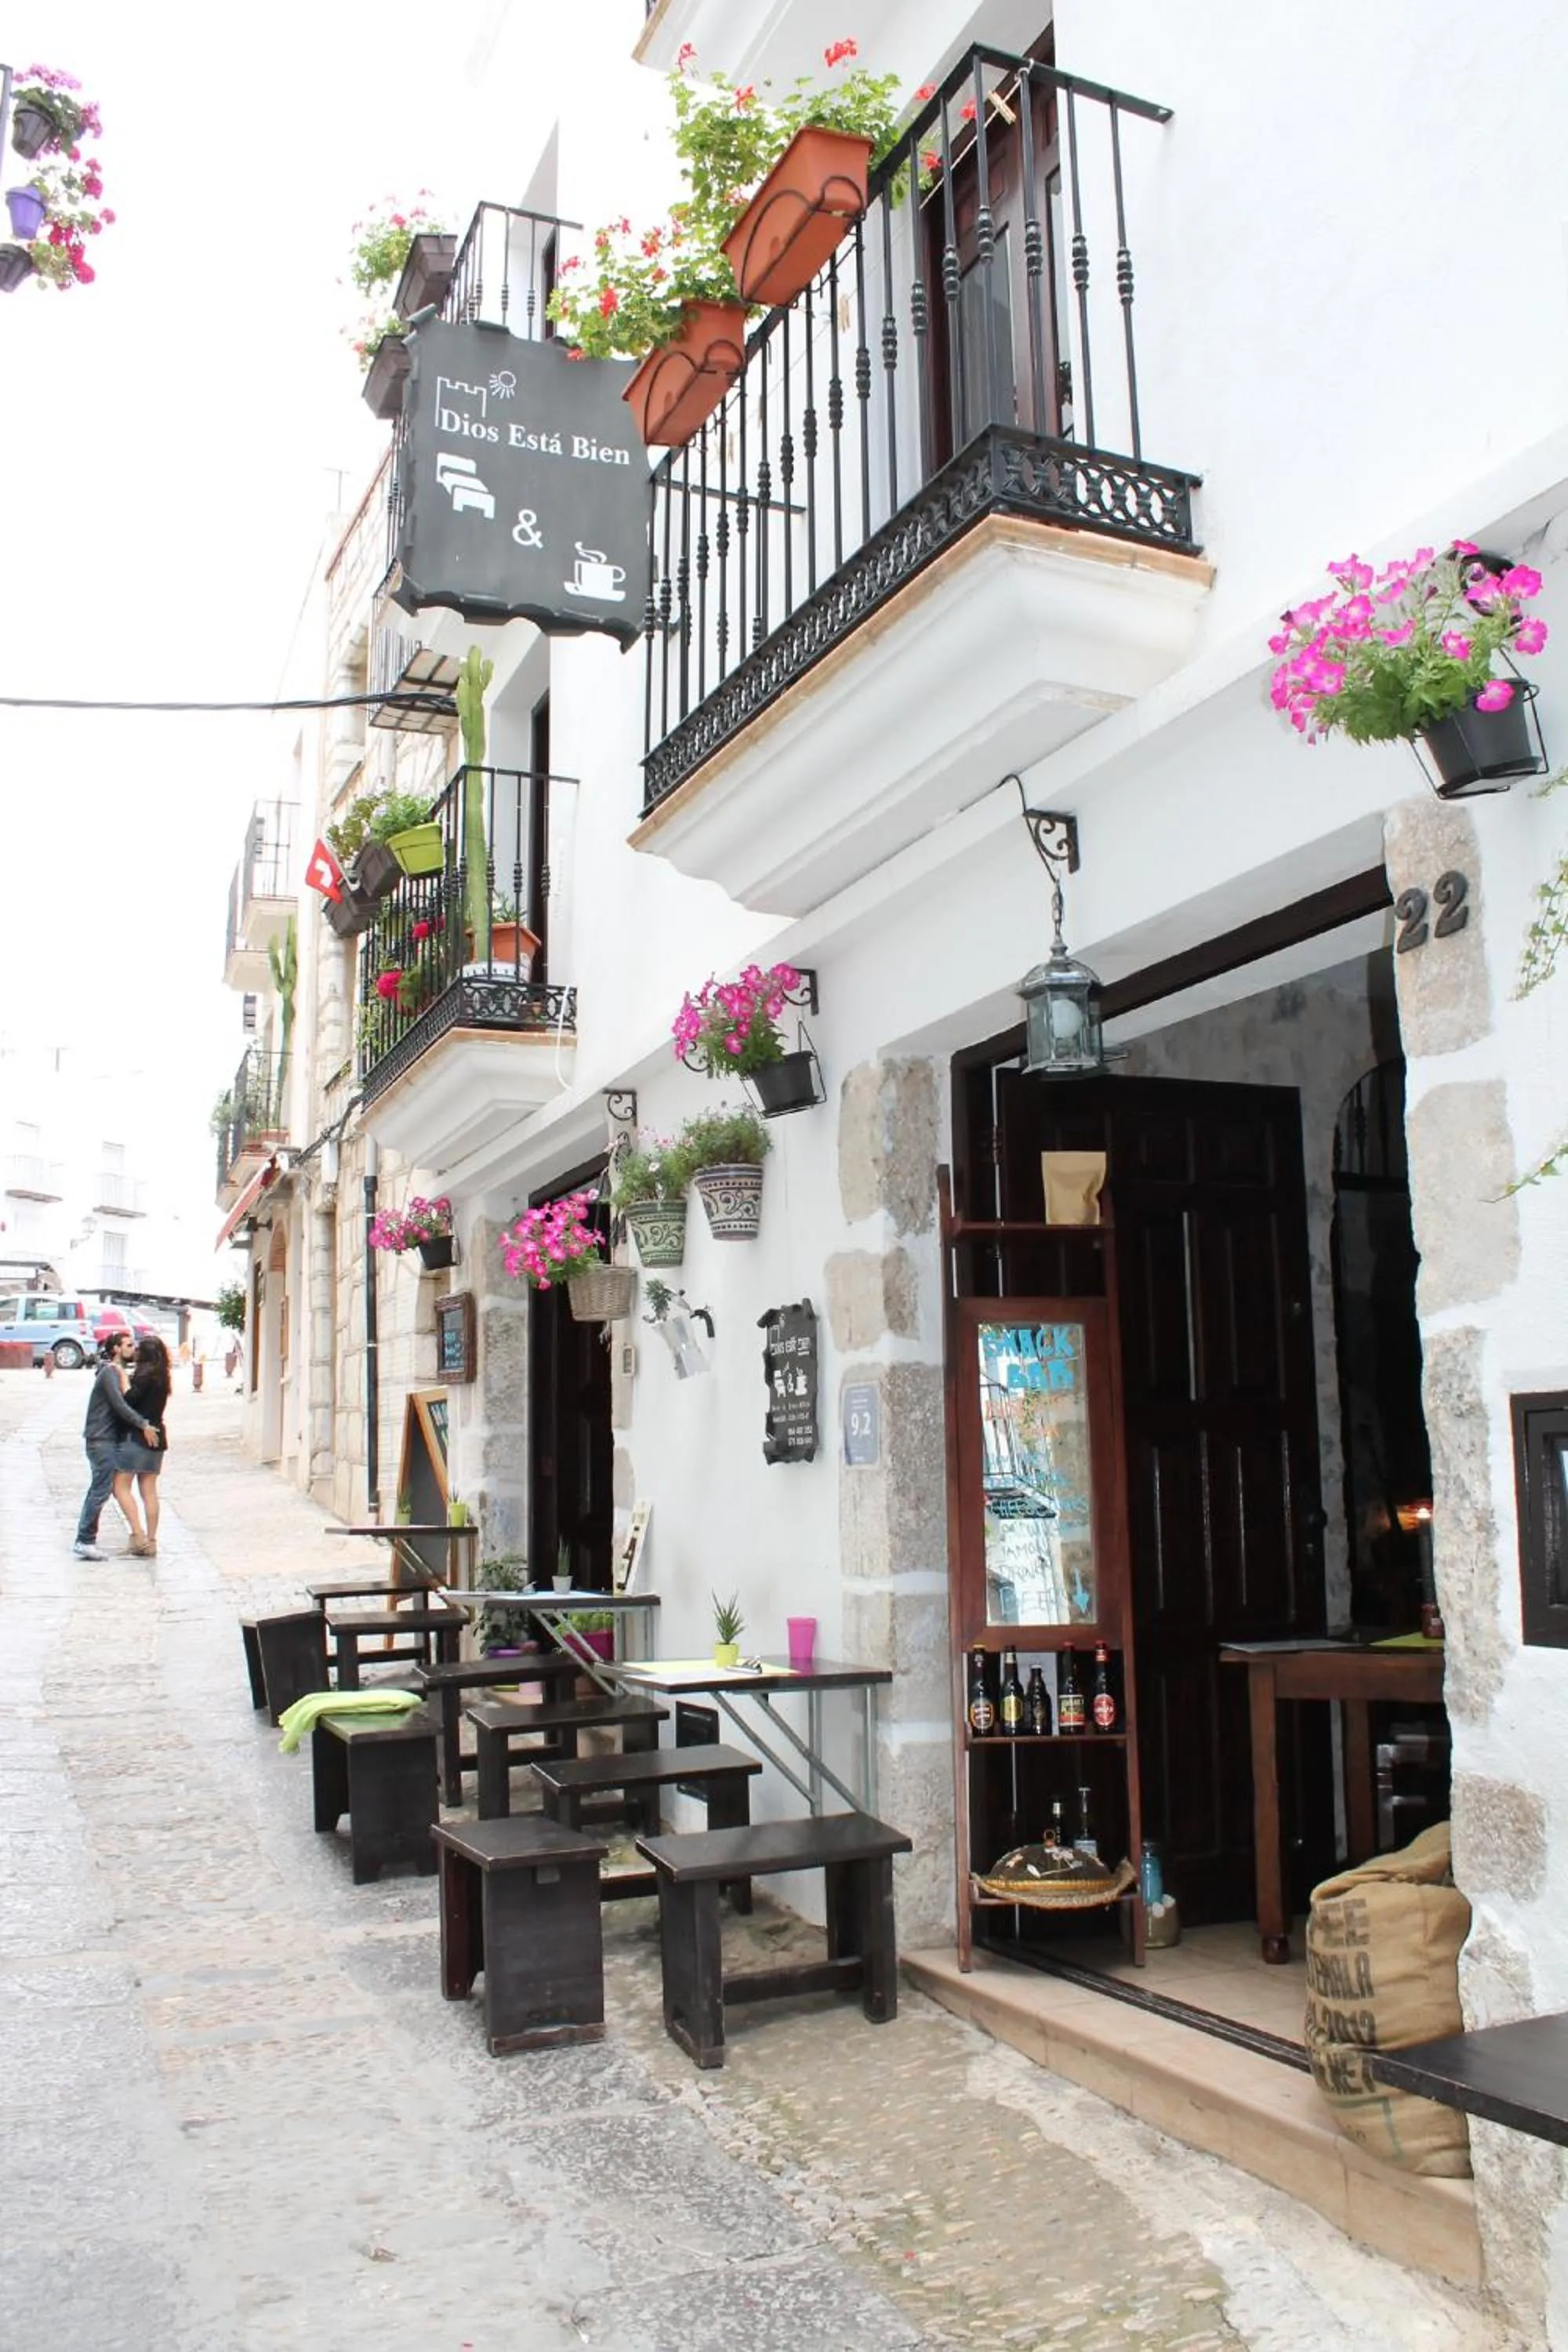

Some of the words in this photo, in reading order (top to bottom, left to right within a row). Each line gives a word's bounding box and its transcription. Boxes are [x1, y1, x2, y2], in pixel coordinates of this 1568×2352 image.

[440, 408, 499, 443] Dios
[508, 423, 563, 456] Está
[571, 436, 630, 466] Bien
[1395, 870, 1469, 954] 22
[983, 1327, 1073, 1358] SNACK
[1006, 1361, 1075, 1390] BAR
